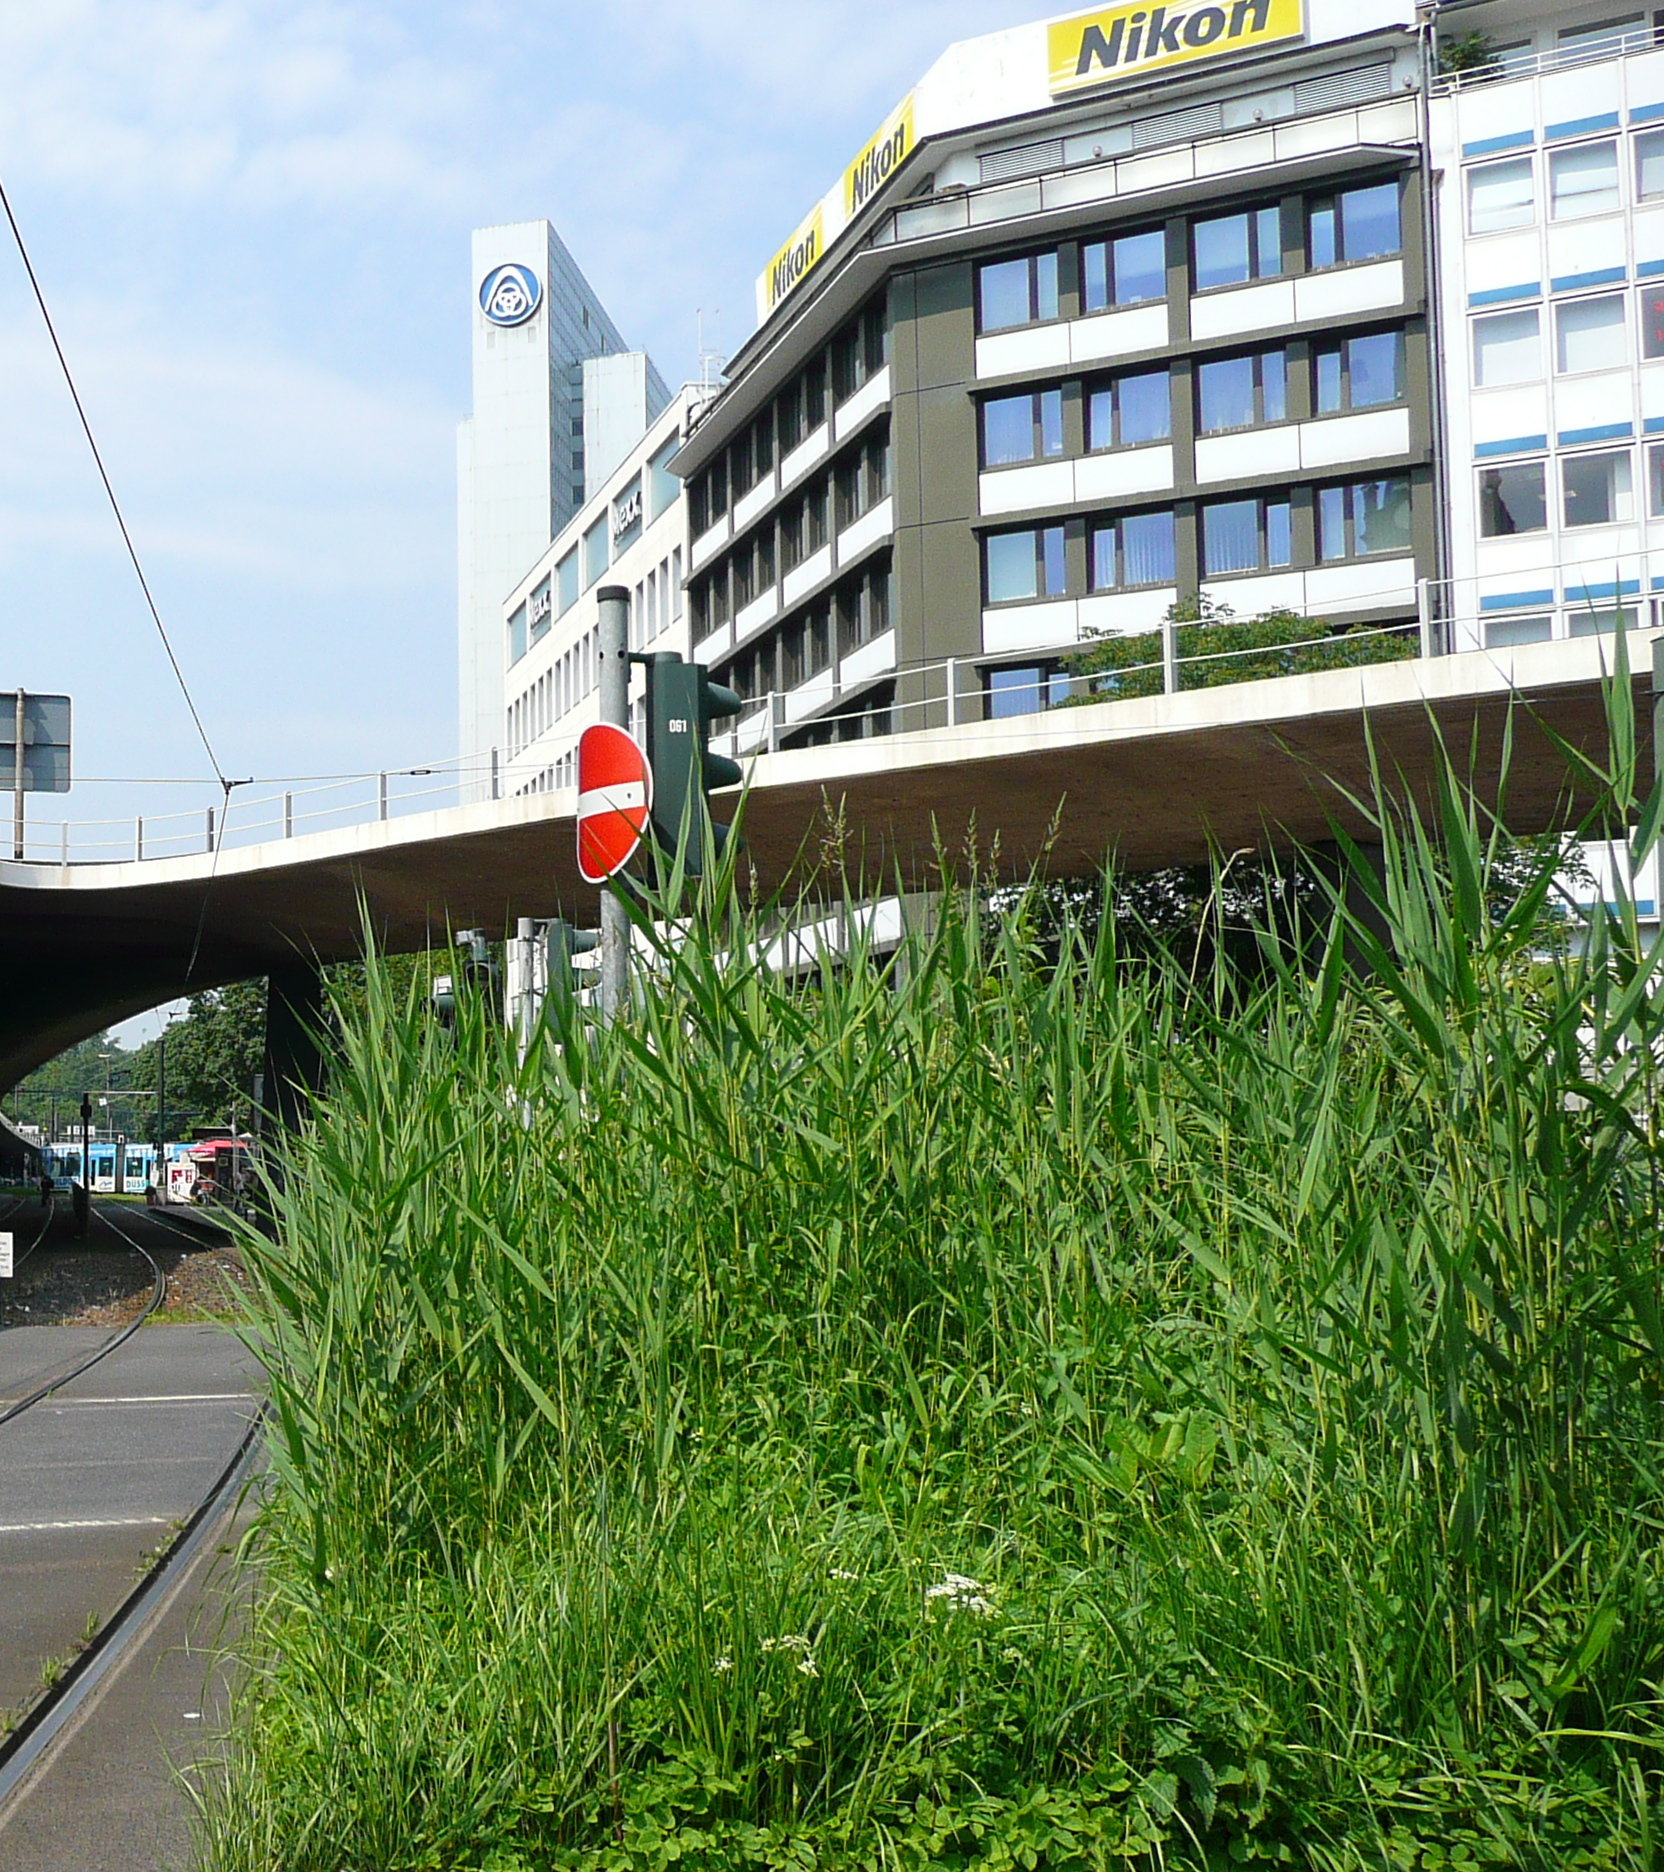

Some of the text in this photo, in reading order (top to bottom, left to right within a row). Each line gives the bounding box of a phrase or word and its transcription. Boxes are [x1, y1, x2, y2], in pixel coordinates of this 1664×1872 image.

[1074, 0, 1270, 76] Nikon
[852, 122, 905, 213] Nikon
[772, 229, 815, 306] Nikon
[669, 719, 687, 733] 061
